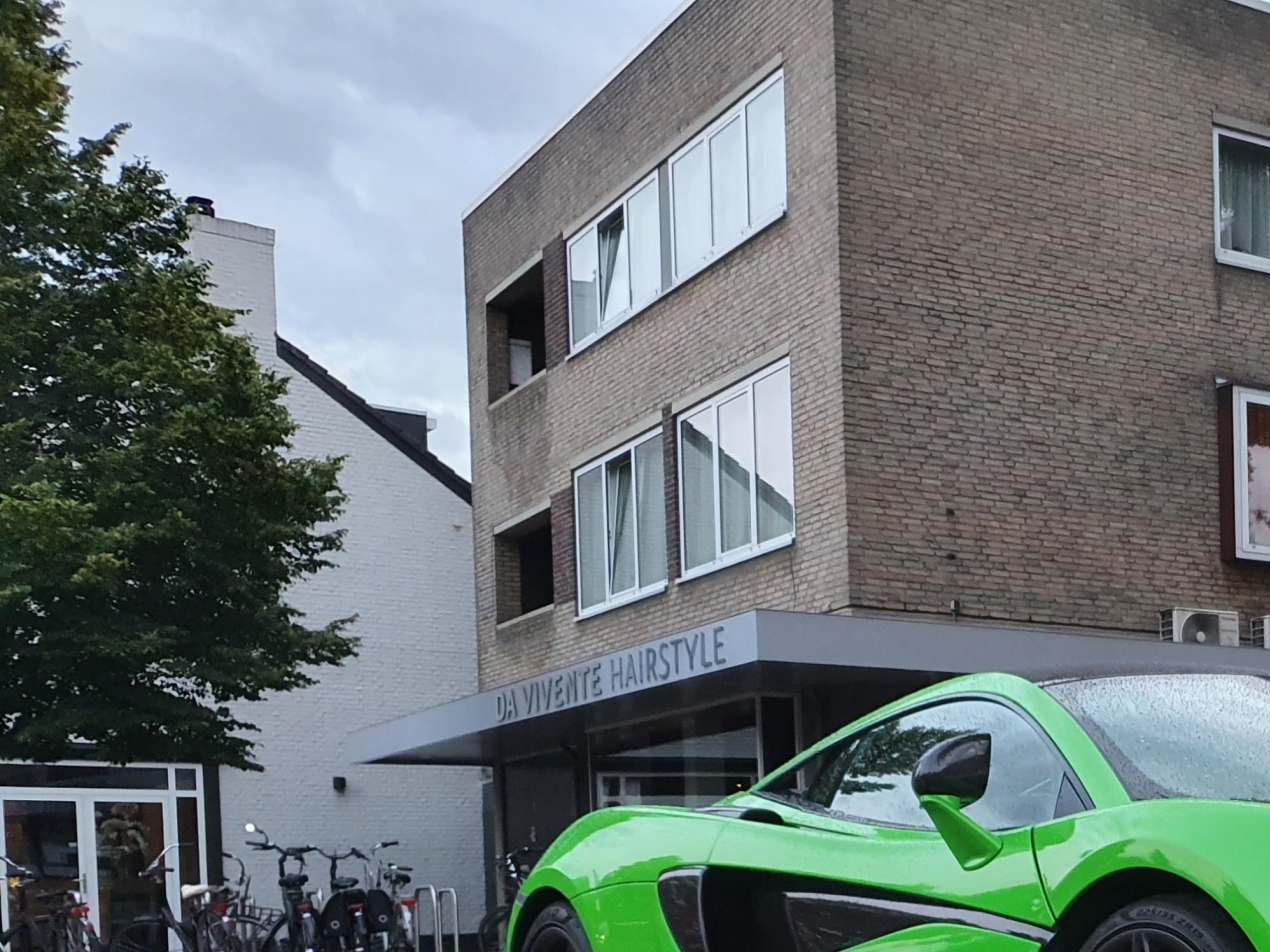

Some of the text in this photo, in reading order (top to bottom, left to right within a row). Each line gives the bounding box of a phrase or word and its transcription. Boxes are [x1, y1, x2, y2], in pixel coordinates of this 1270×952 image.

[496, 626, 728, 722] DA VIVENTE HAIRSTYLE
